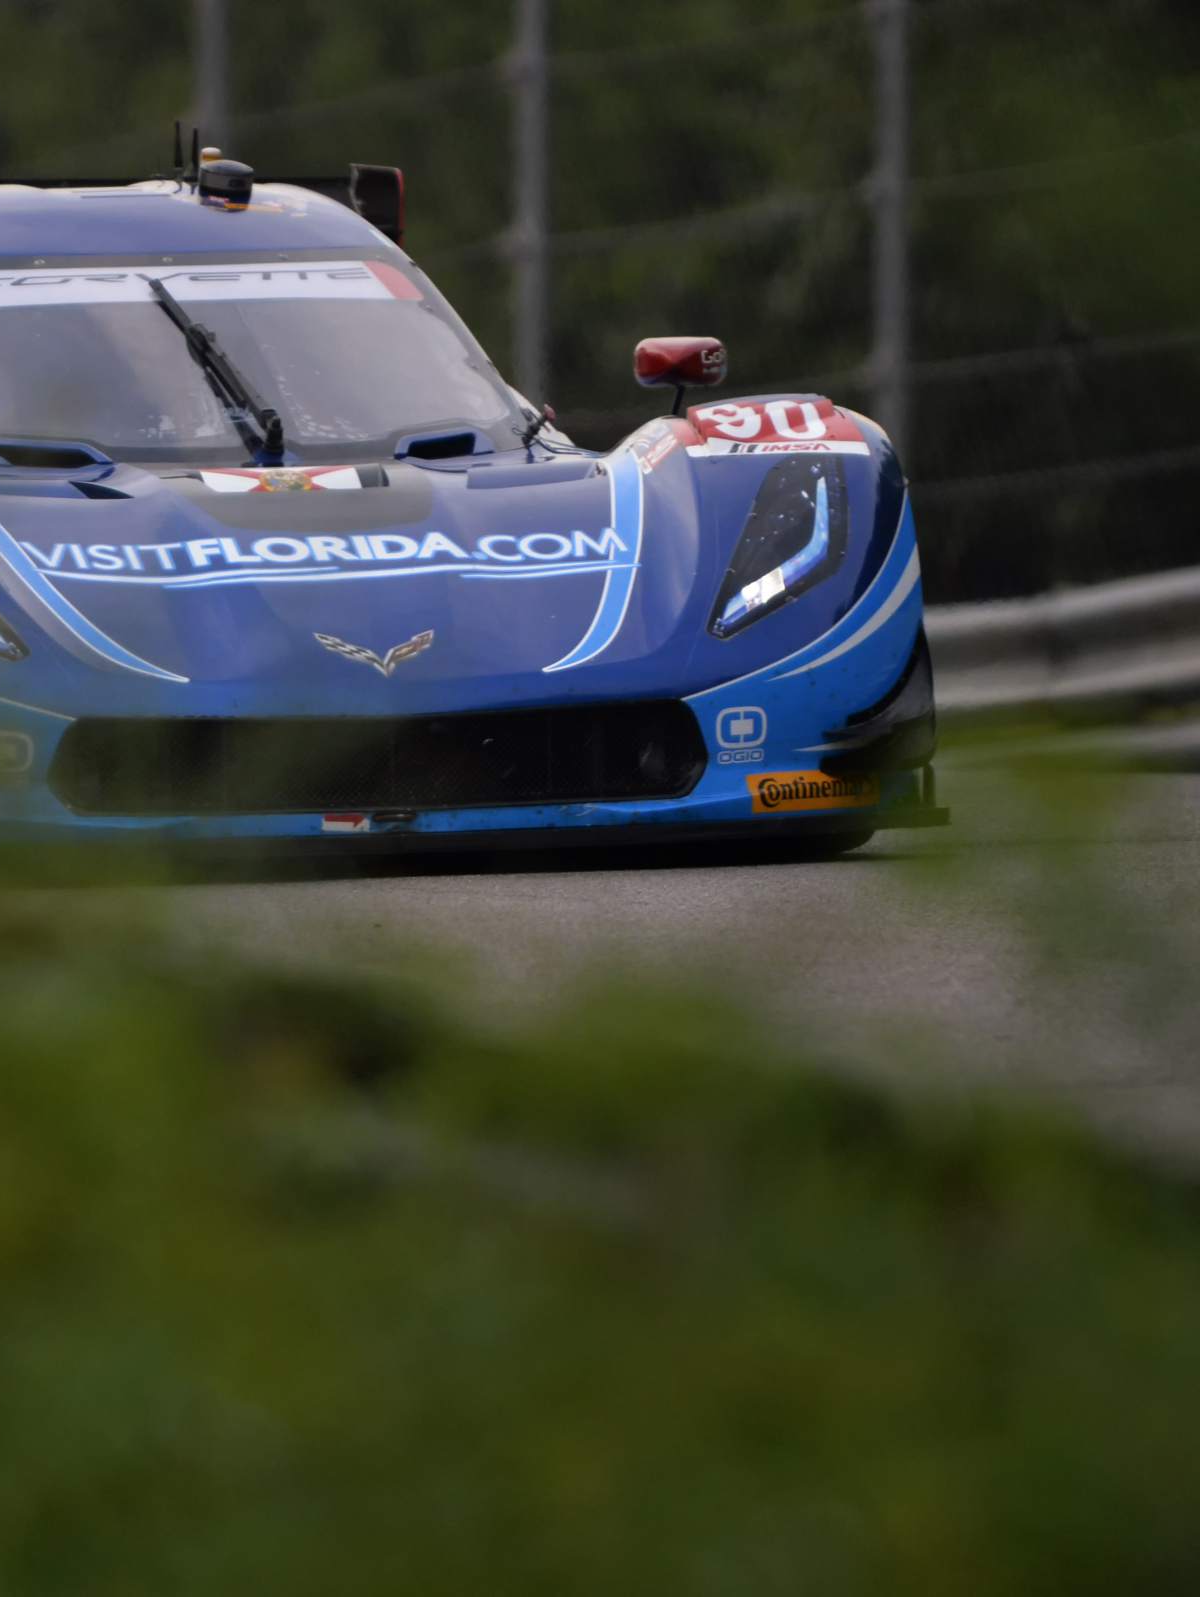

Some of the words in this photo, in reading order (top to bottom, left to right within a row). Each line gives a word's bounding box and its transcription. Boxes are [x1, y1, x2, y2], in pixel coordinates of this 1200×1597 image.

[696, 400, 827, 439] 90
[23, 528, 628, 570] VISITFLORIDA.COM
[718, 750, 764, 764] OGIO
